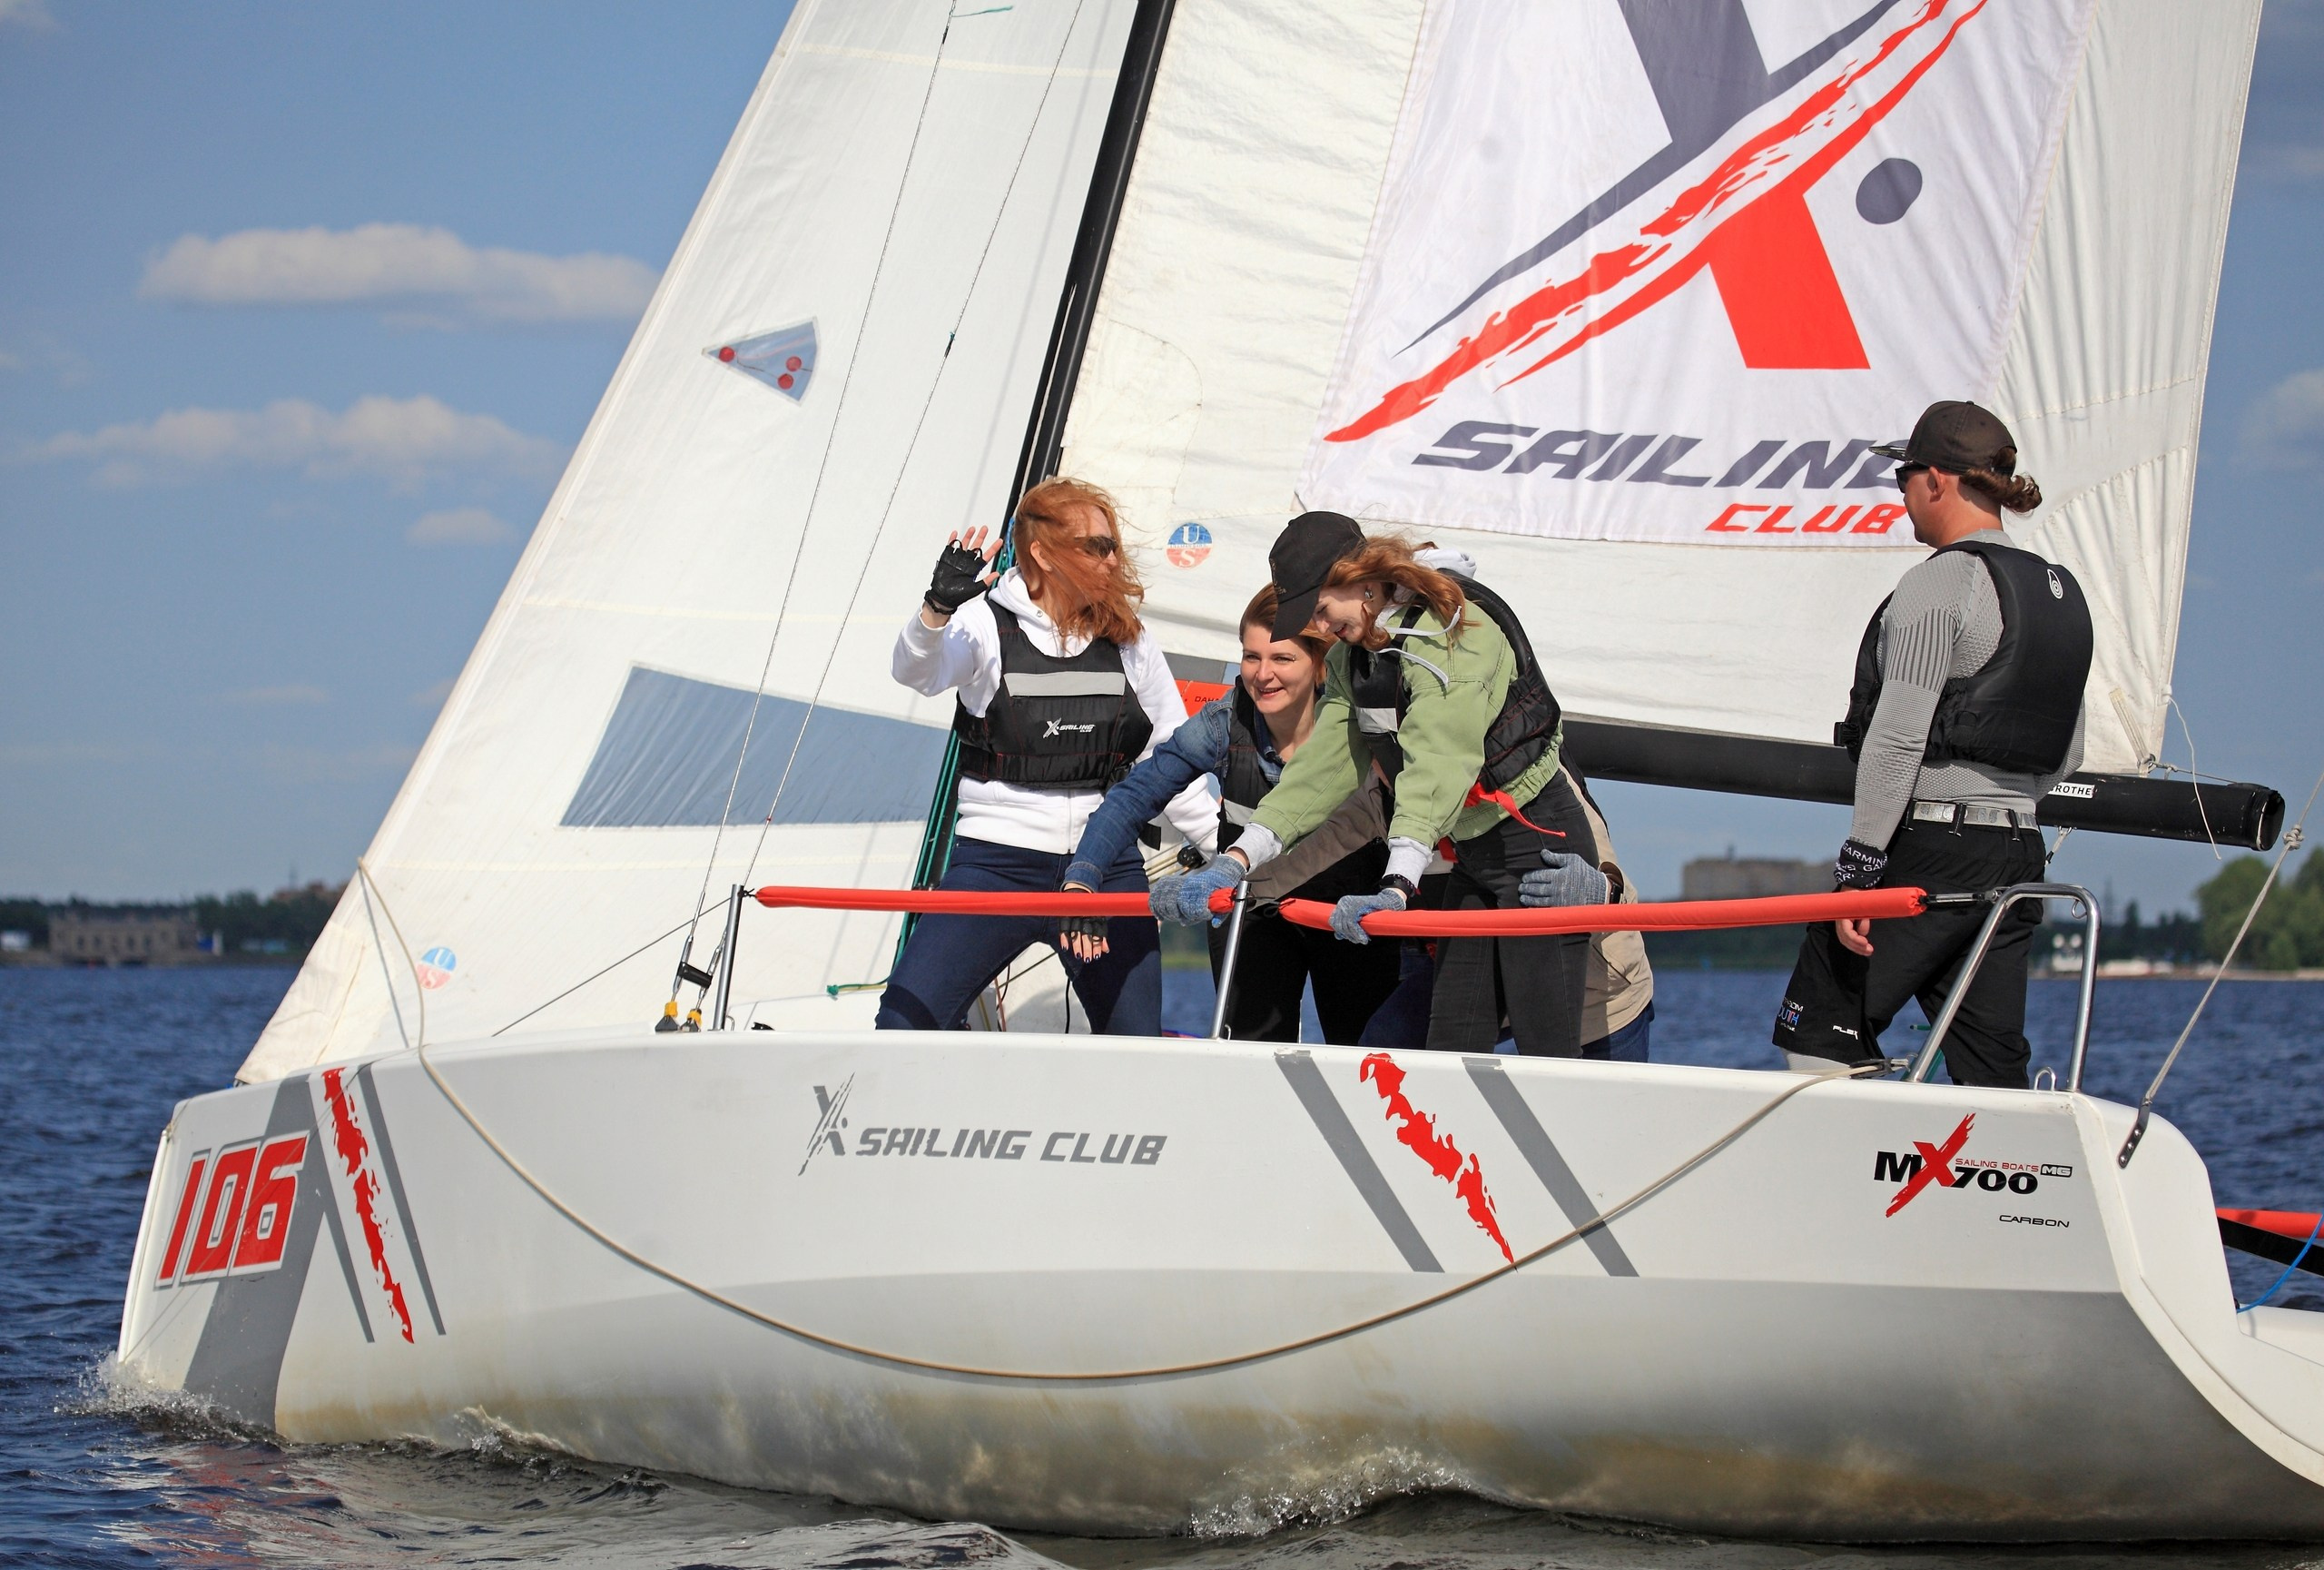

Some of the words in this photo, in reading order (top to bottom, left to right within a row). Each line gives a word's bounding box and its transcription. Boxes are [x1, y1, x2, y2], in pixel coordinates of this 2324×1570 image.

[1705, 504, 1909, 534] CLUB
[1842, 842, 1884, 869] GARMIN
[855, 1127, 1032, 1160] SAILING
[1039, 1132, 1167, 1166] CLUB
[1955, 1158, 1998, 1169] SAILING
[2040, 1163, 2073, 1178] MG
[154, 1132, 310, 1290] 106
[1999, 1214, 2070, 1229] CARBON
